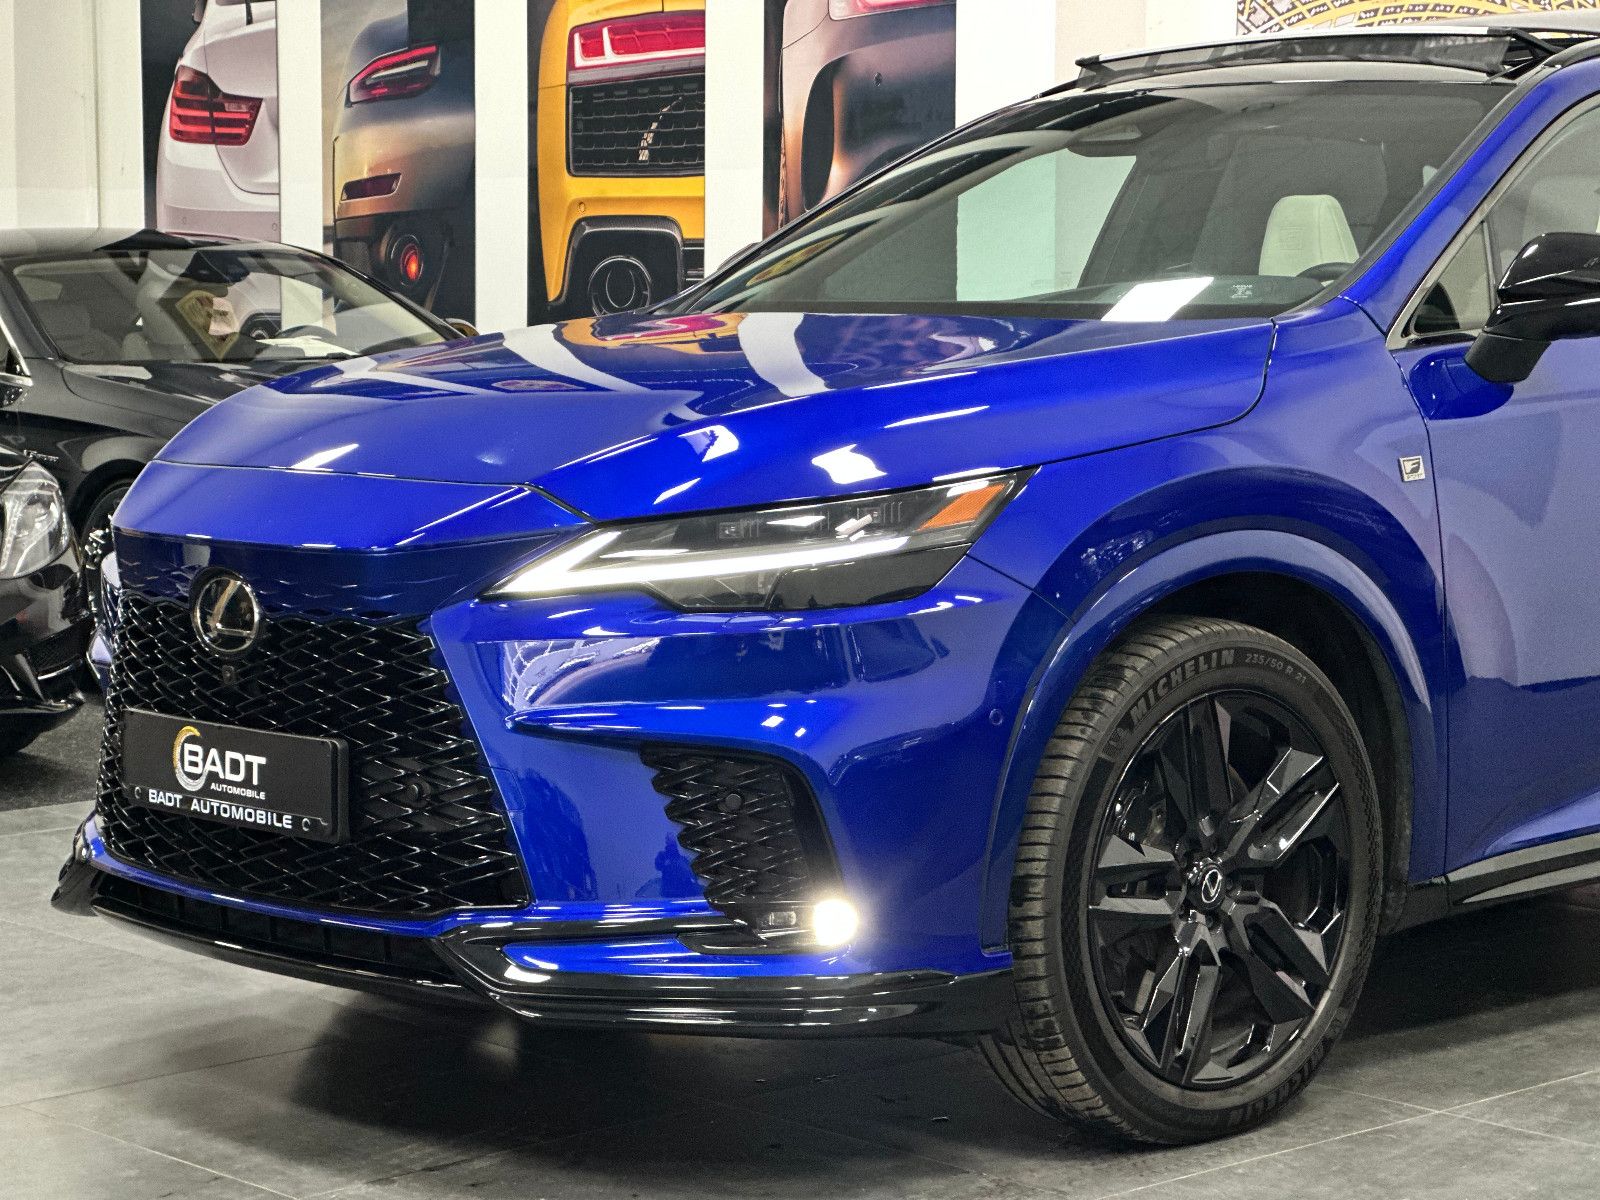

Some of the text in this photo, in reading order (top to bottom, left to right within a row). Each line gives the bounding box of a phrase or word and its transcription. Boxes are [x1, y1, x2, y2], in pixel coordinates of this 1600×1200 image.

[1129, 649, 1235, 725] MICHELIN
[183, 743, 267, 786] BADT
[148, 789, 292, 829] BADT AUTOMOBILE
[210, 782, 266, 800] AUTOMOBILE
